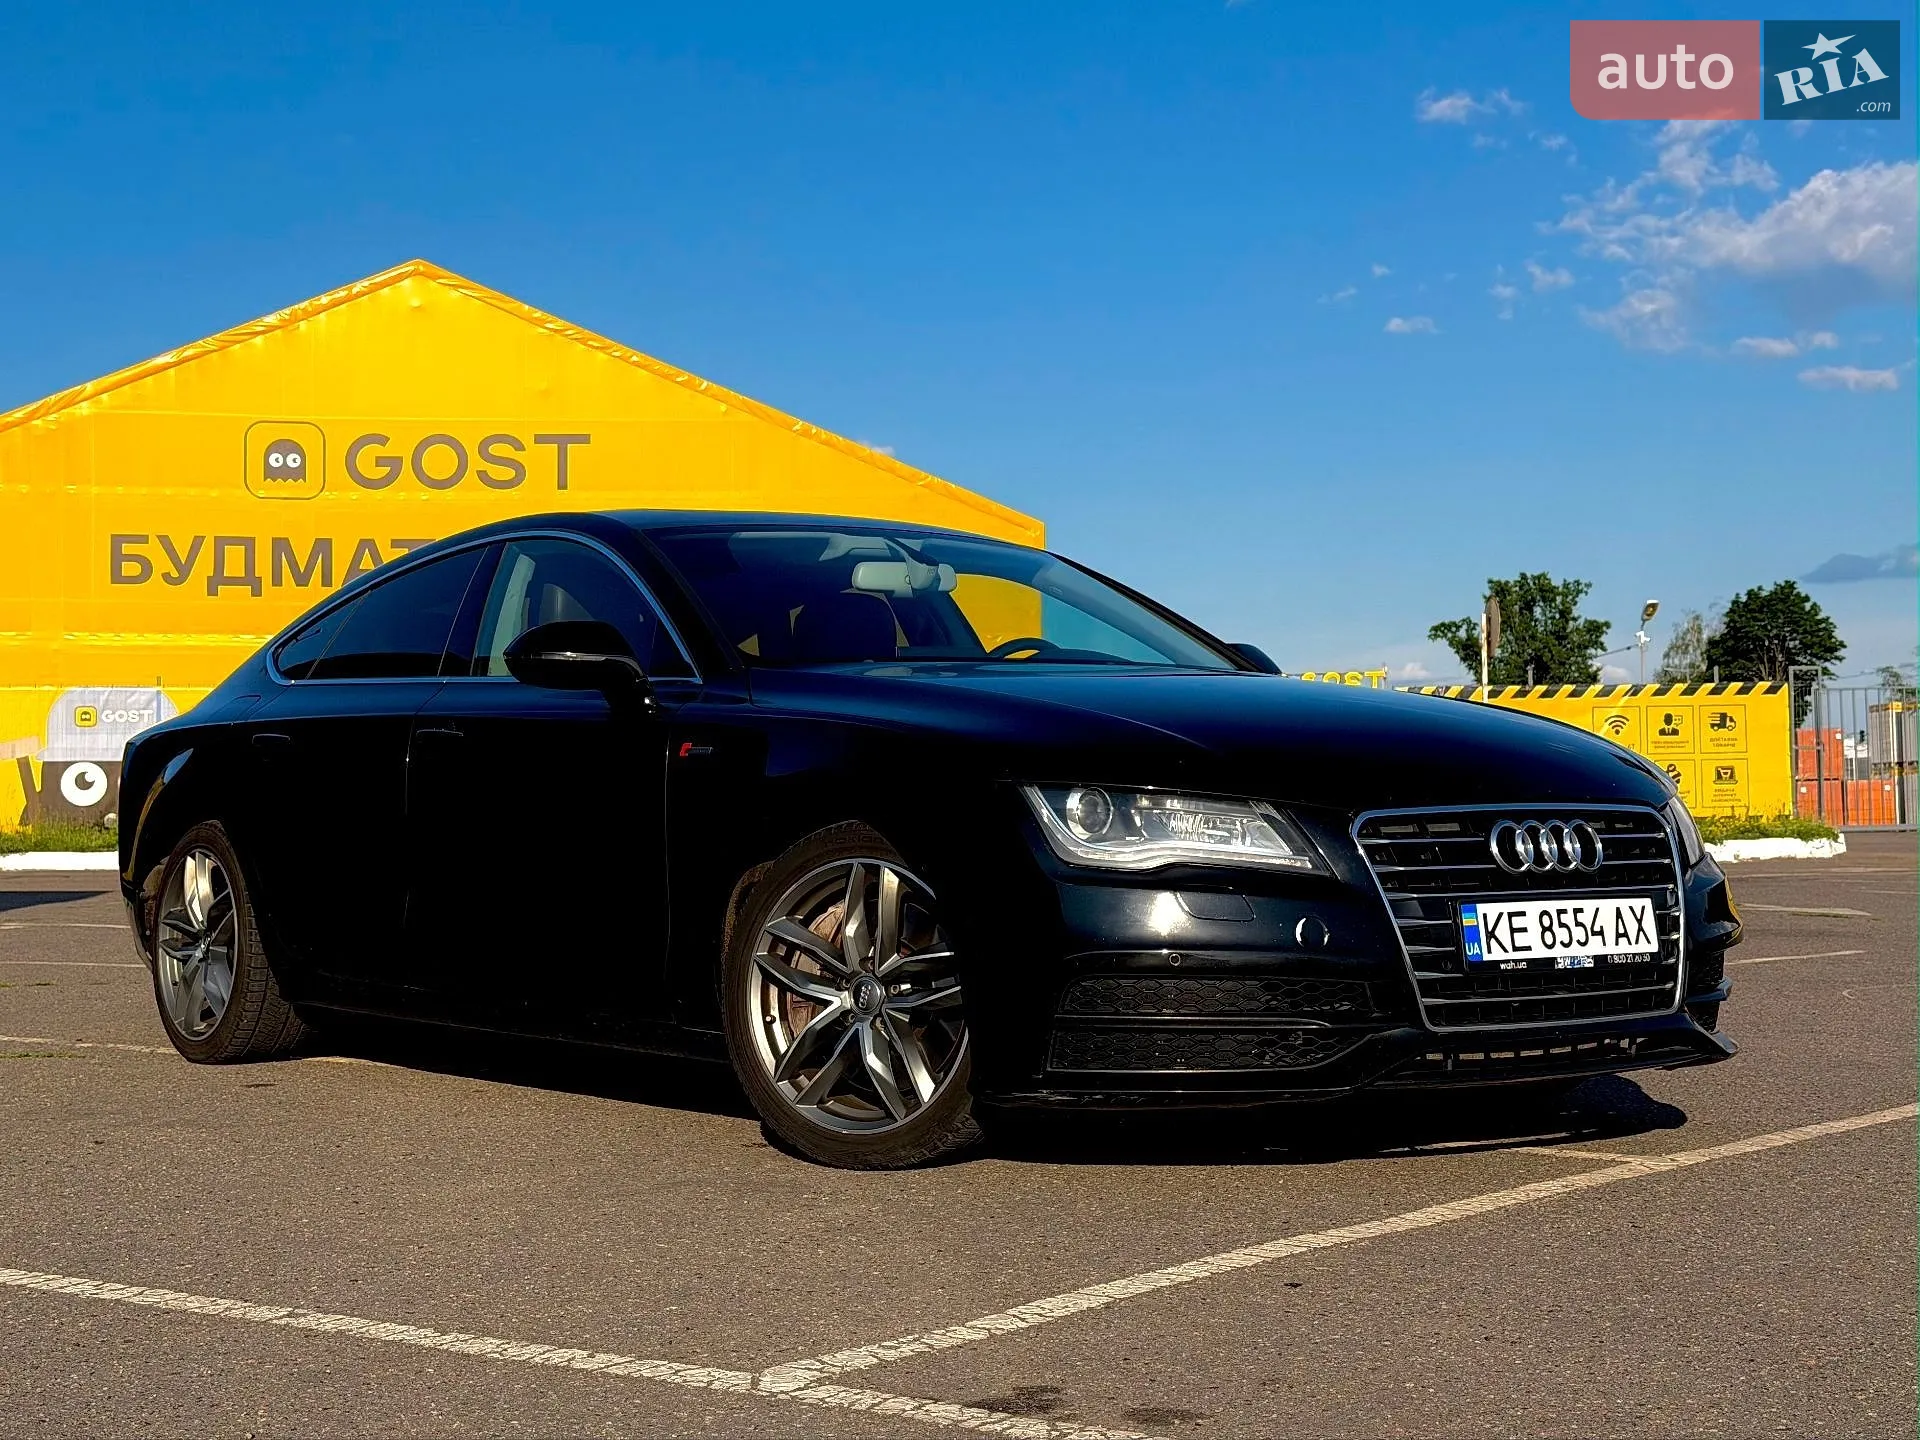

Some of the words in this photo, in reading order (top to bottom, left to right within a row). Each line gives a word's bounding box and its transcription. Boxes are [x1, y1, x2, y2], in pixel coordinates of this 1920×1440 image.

[345, 433, 591, 491] GOST
[101, 709, 154, 723] GOST
[1482, 911, 1532, 954] KE
[1538, 907, 1607, 950] 8554
[1614, 905, 1652, 946] AX
[1465, 943, 1481, 956] UA
[1500, 961, 1528, 969] wah.ua
